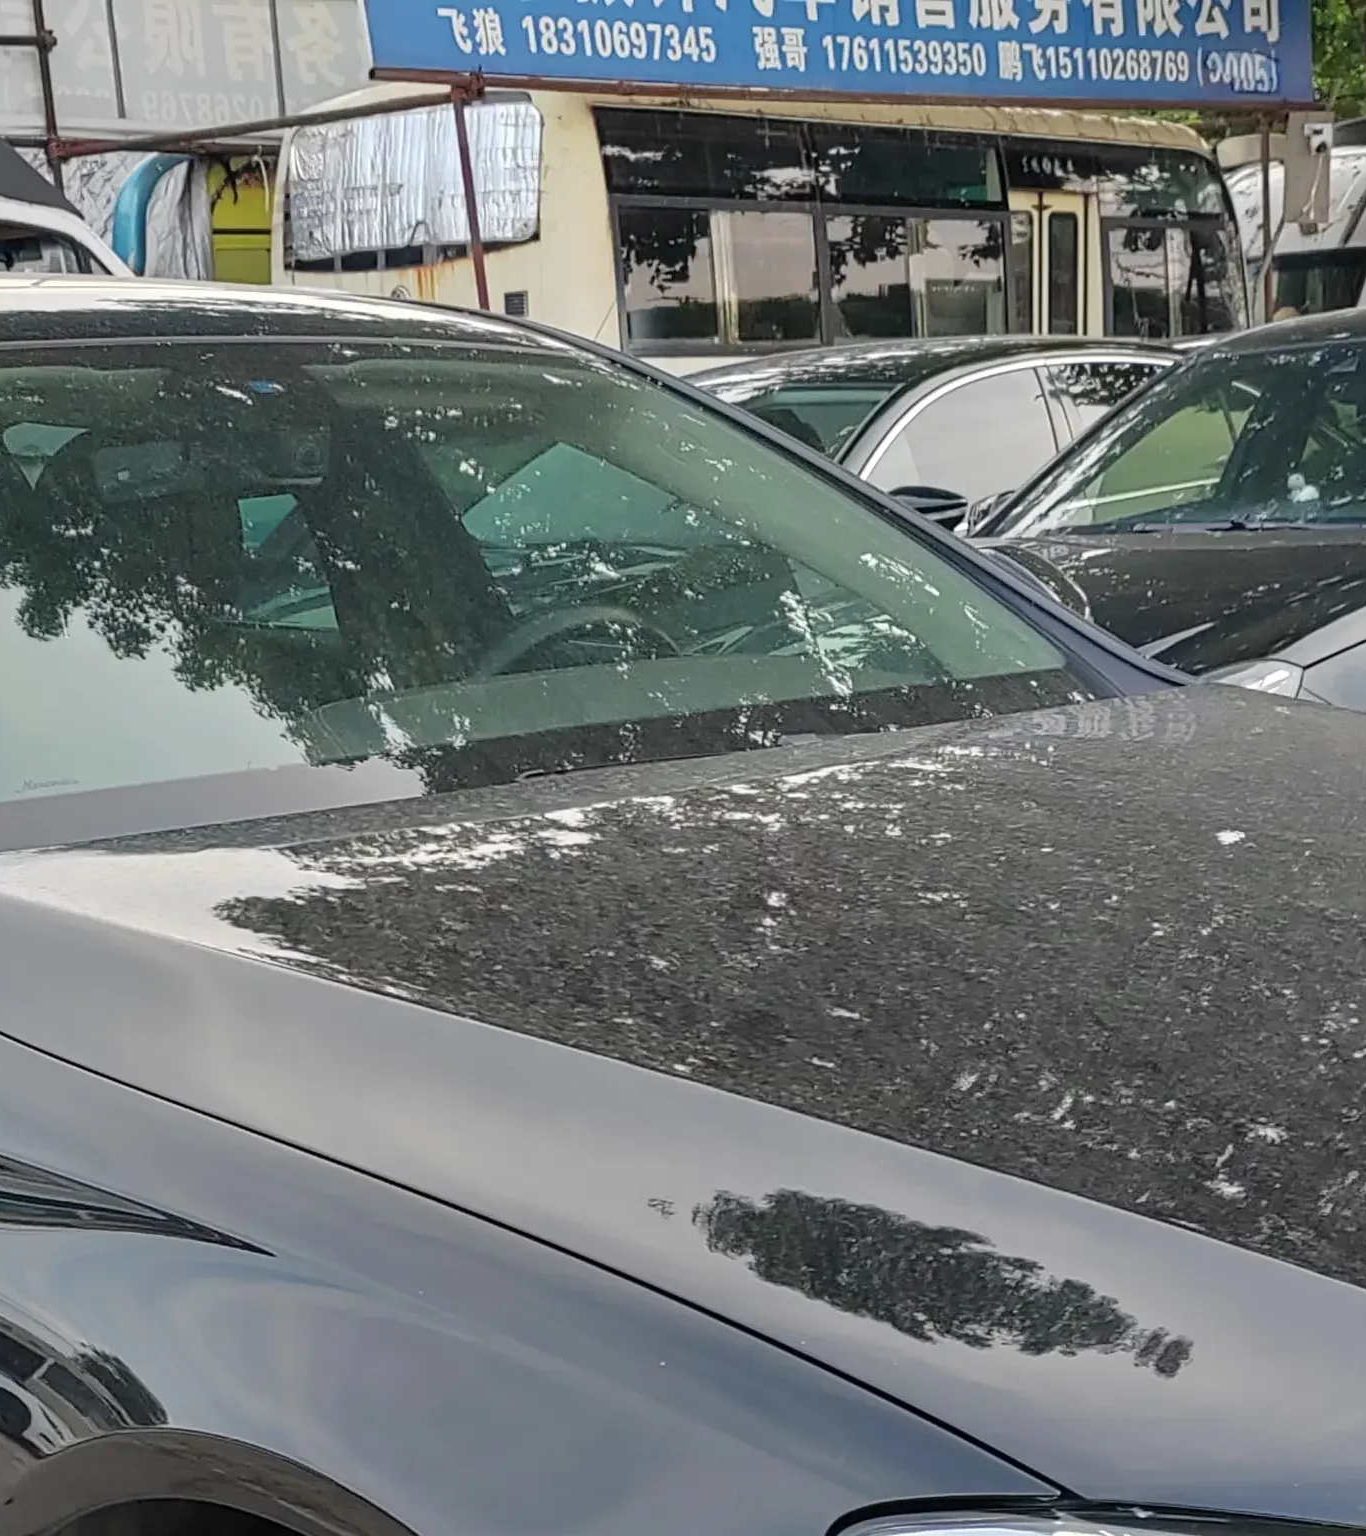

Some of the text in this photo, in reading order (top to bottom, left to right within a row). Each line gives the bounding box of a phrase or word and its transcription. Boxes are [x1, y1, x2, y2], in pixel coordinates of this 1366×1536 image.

[437, 7, 507, 57] 飞狼
[521, 14, 717, 63] 18310697345
[752, 26, 809, 72] 强哥
[822, 35, 987, 77] 17611539350
